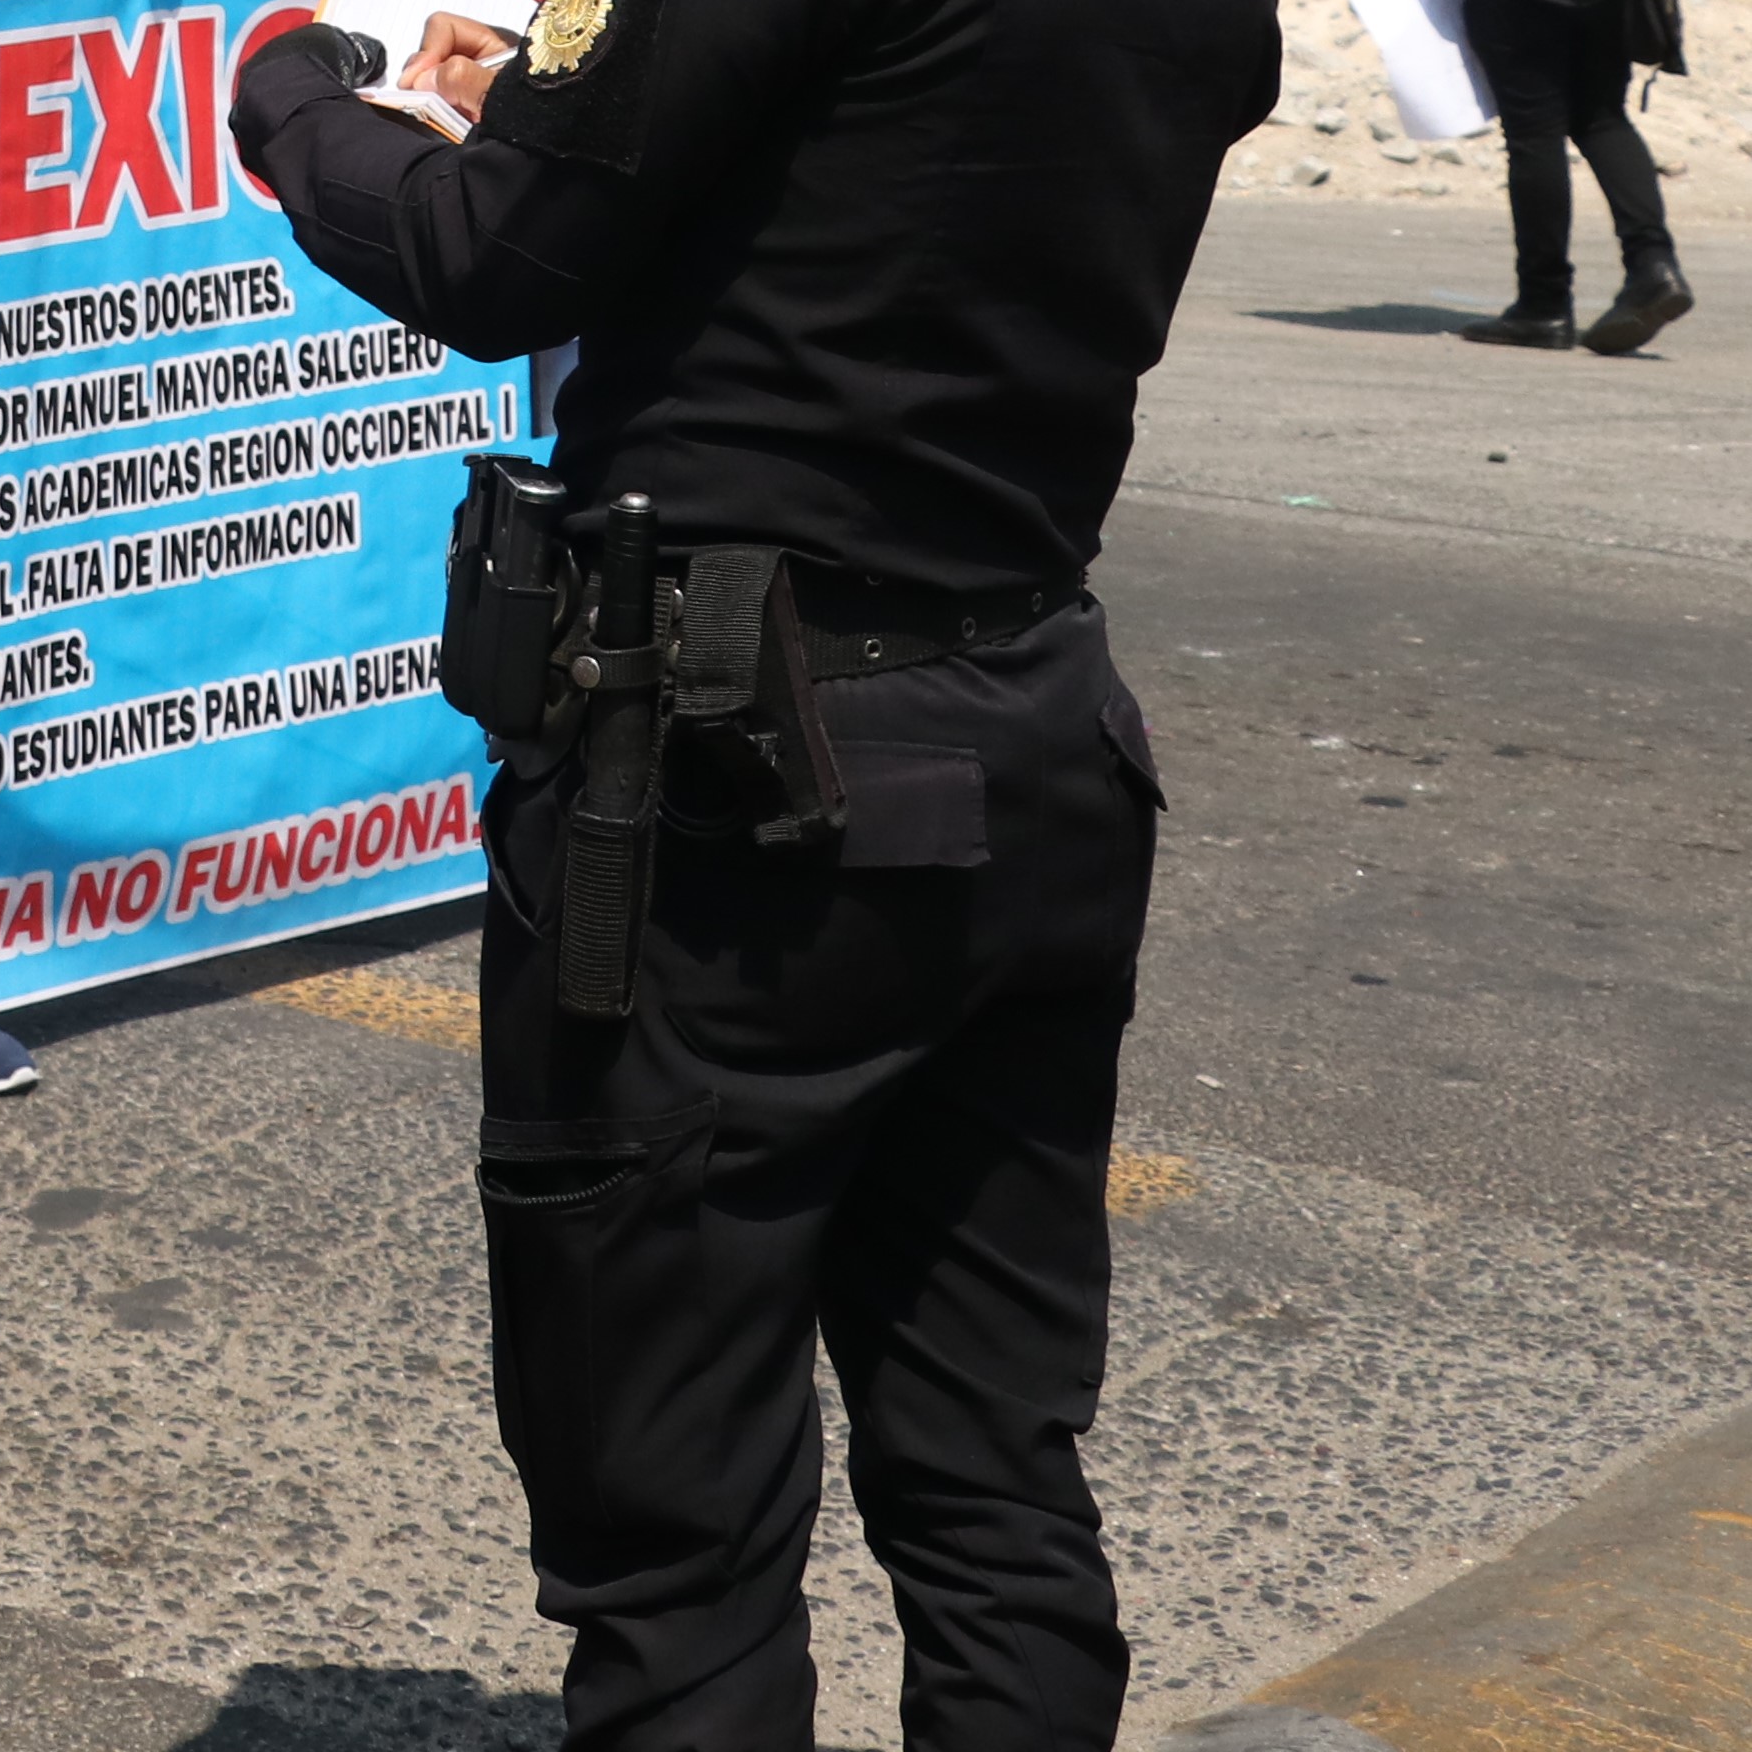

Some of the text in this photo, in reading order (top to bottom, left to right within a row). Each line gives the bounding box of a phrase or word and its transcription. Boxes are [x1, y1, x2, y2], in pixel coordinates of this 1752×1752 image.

[145, 263, 289, 333] DOCENTES.
[36, 371, 150, 438] MANUEL
[156, 346, 291, 415] MAYORGA
[23, 444, 201, 527] ACADEMICAS
[209, 423, 314, 489] REGION
[322, 395, 490, 466] OCCIDENTAL
[113, 538, 153, 591] DE
[161, 499, 355, 583] INFORMACION
[13, 694, 196, 783] ESTUDIANTES
[205, 677, 283, 738] PARA
[290, 662, 347, 718] UNA
[355, 642, 442, 704] BUENA
[65, 859, 161, 936] NO
